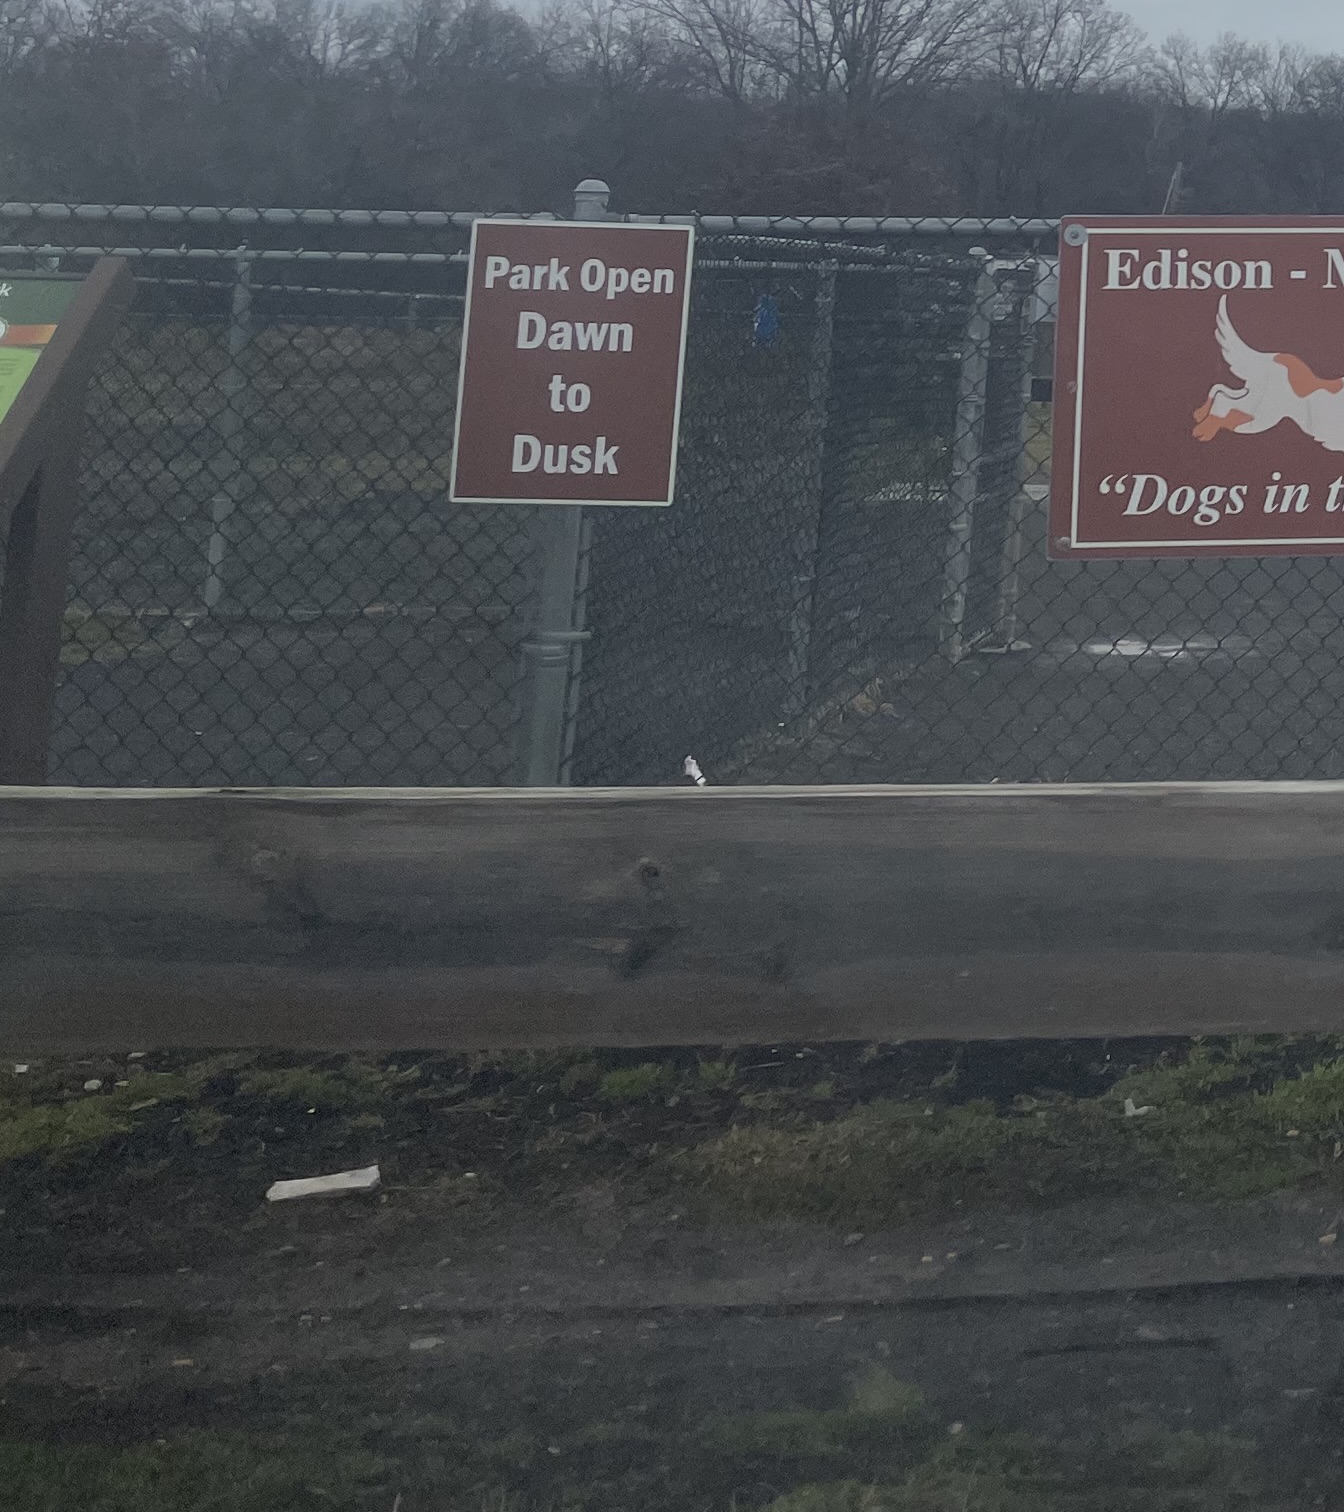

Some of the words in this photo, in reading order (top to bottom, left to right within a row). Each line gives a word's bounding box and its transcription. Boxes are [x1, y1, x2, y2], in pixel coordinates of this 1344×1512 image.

[484, 256, 571, 291] Park
[580, 258, 675, 299] Open
[1101, 248, 1274, 290] Edison
[517, 311, 634, 352] Dawn
[549, 374, 591, 413] to
[512, 434, 620, 475] Dusk
[1098, 472, 1248, 526] “Dogs
[1263, 471, 1310, 515] in
